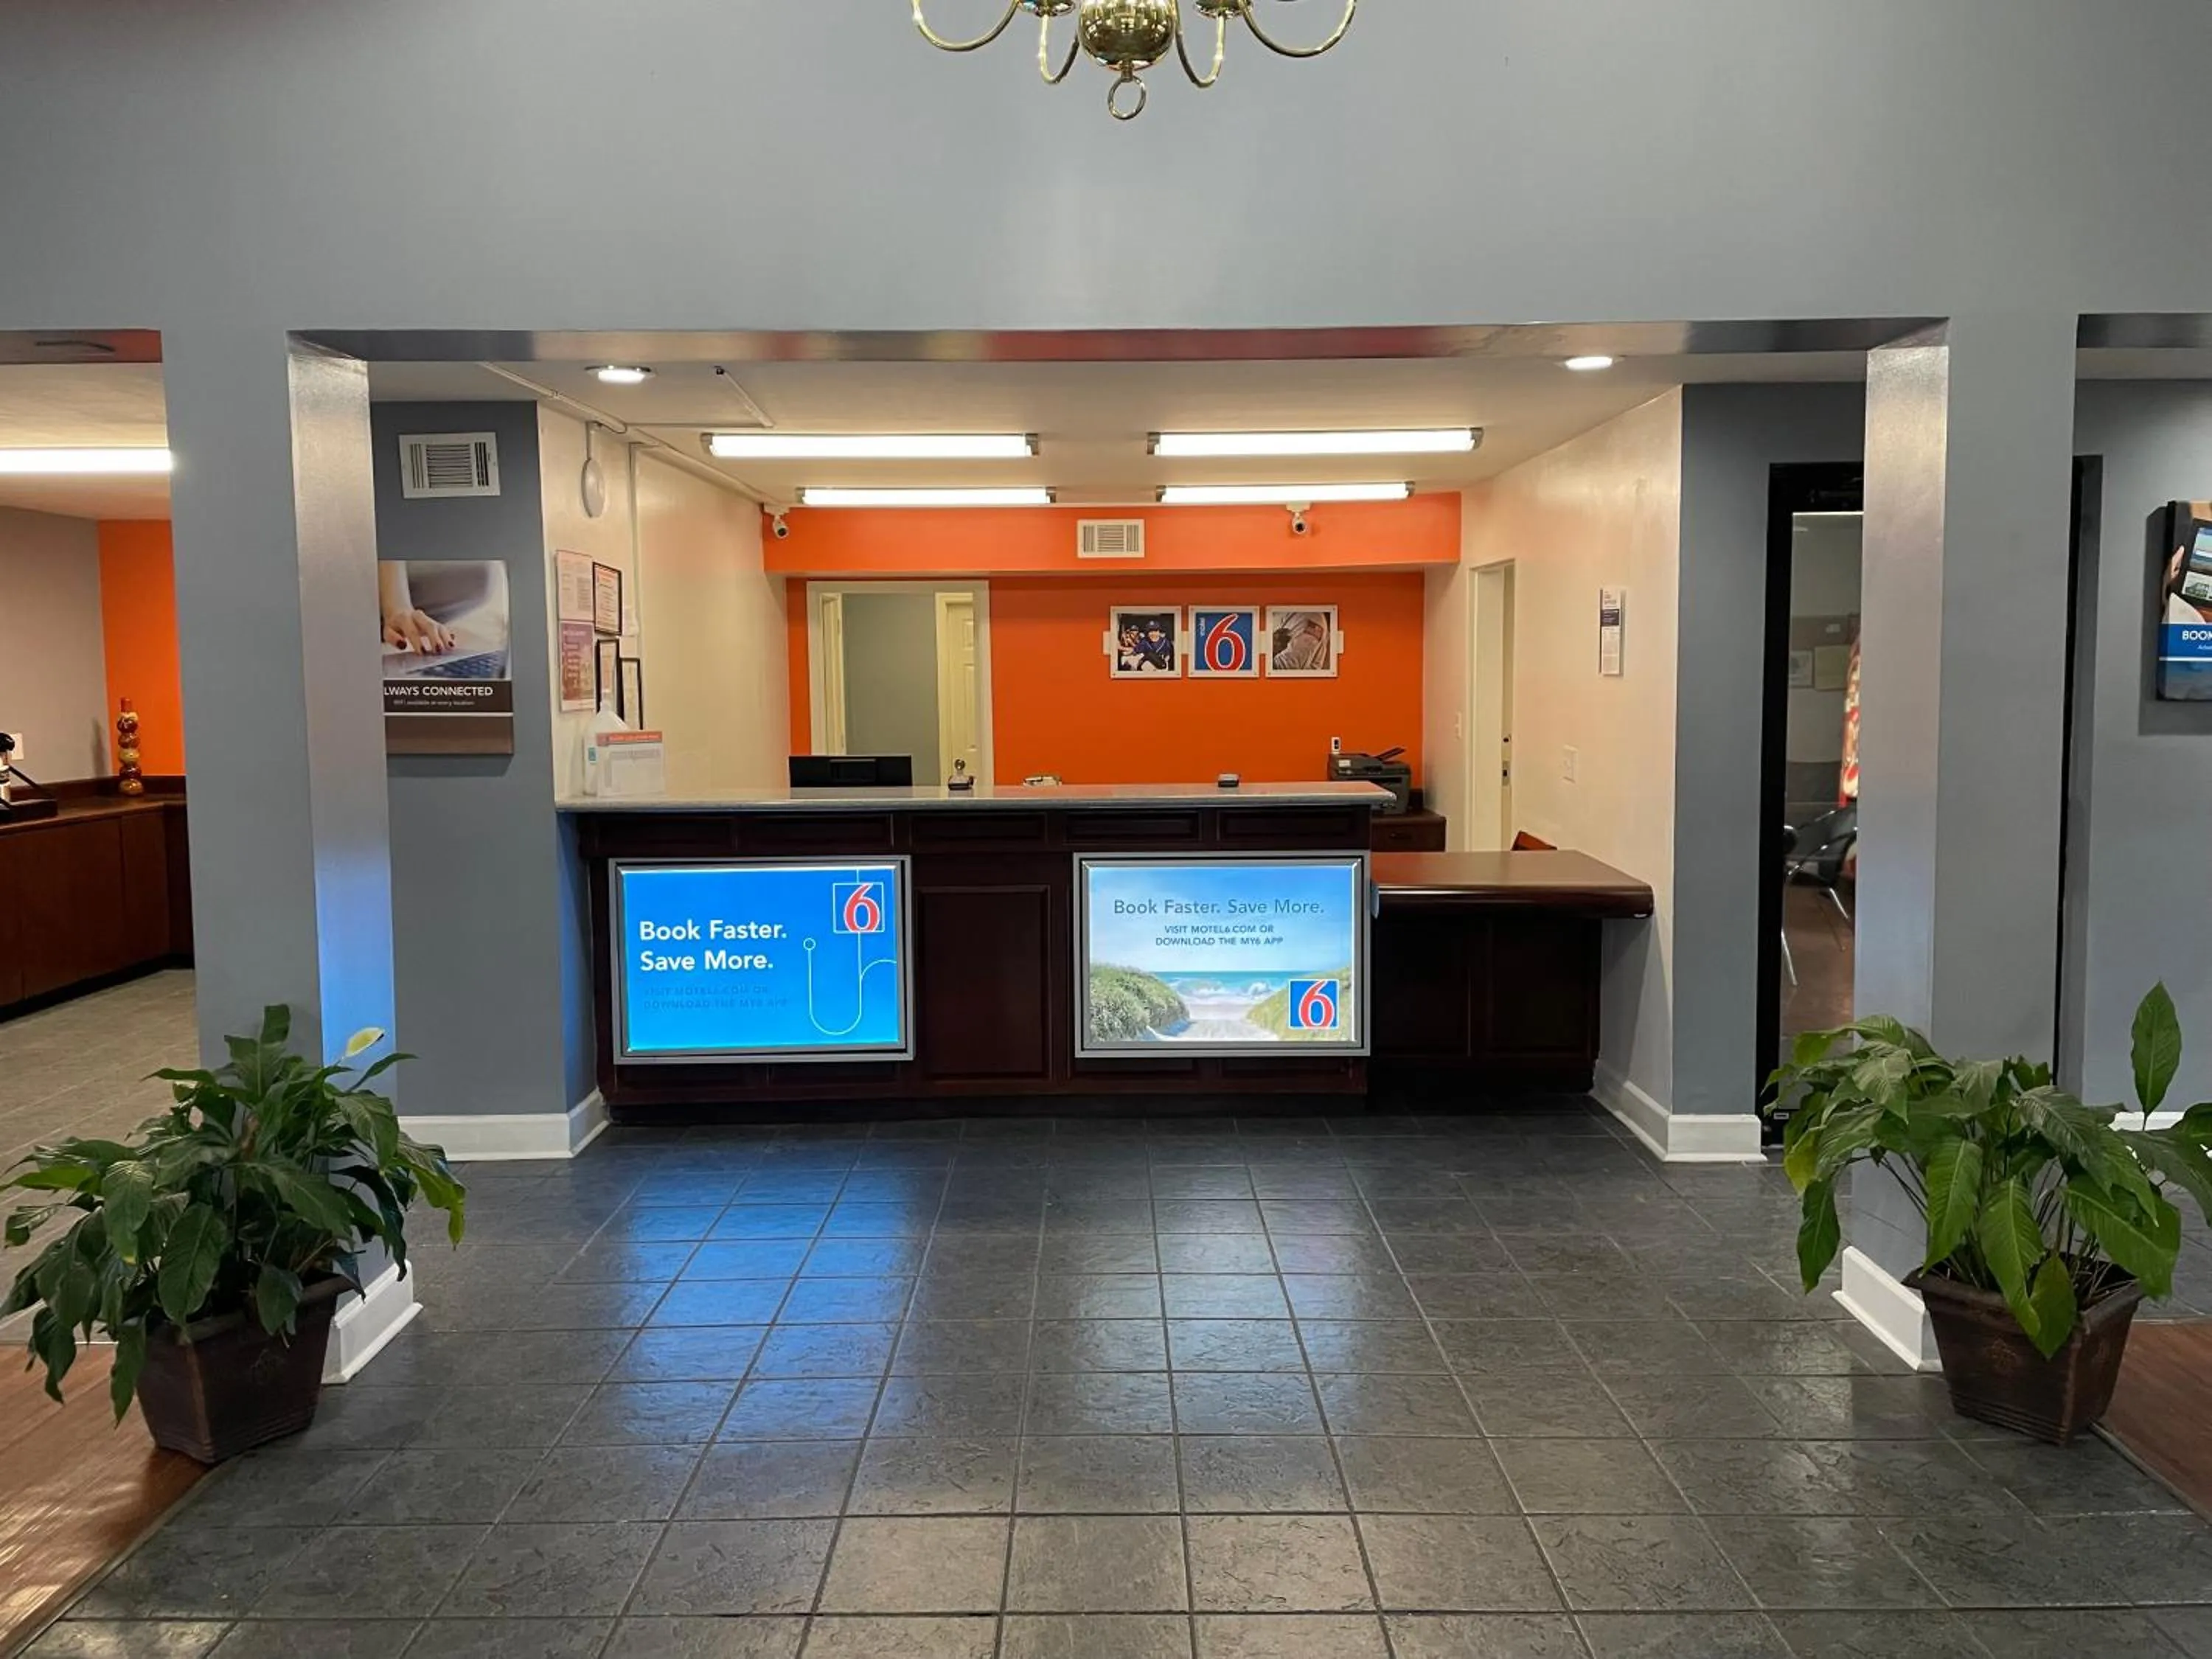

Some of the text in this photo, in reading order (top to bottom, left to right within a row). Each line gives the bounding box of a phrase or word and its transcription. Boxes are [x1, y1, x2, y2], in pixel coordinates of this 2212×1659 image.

[1204, 613, 1246, 672] 6
[383, 686, 493, 697] LWAYS CONNECTED
[843, 882, 881, 932] 6
[1114, 898, 1324, 914] Book Faster. Save More.
[639, 919, 787, 941] Book Faster.
[1164, 925, 1188, 934] VISIT
[1259, 924, 1275, 933] OR
[1155, 937, 1216, 946] DOWNLOAD
[1218, 936, 1237, 945] THE
[1263, 936, 1284, 945] APP
[639, 949, 773, 972] Save More.
[1298, 979, 1336, 1029] 6
